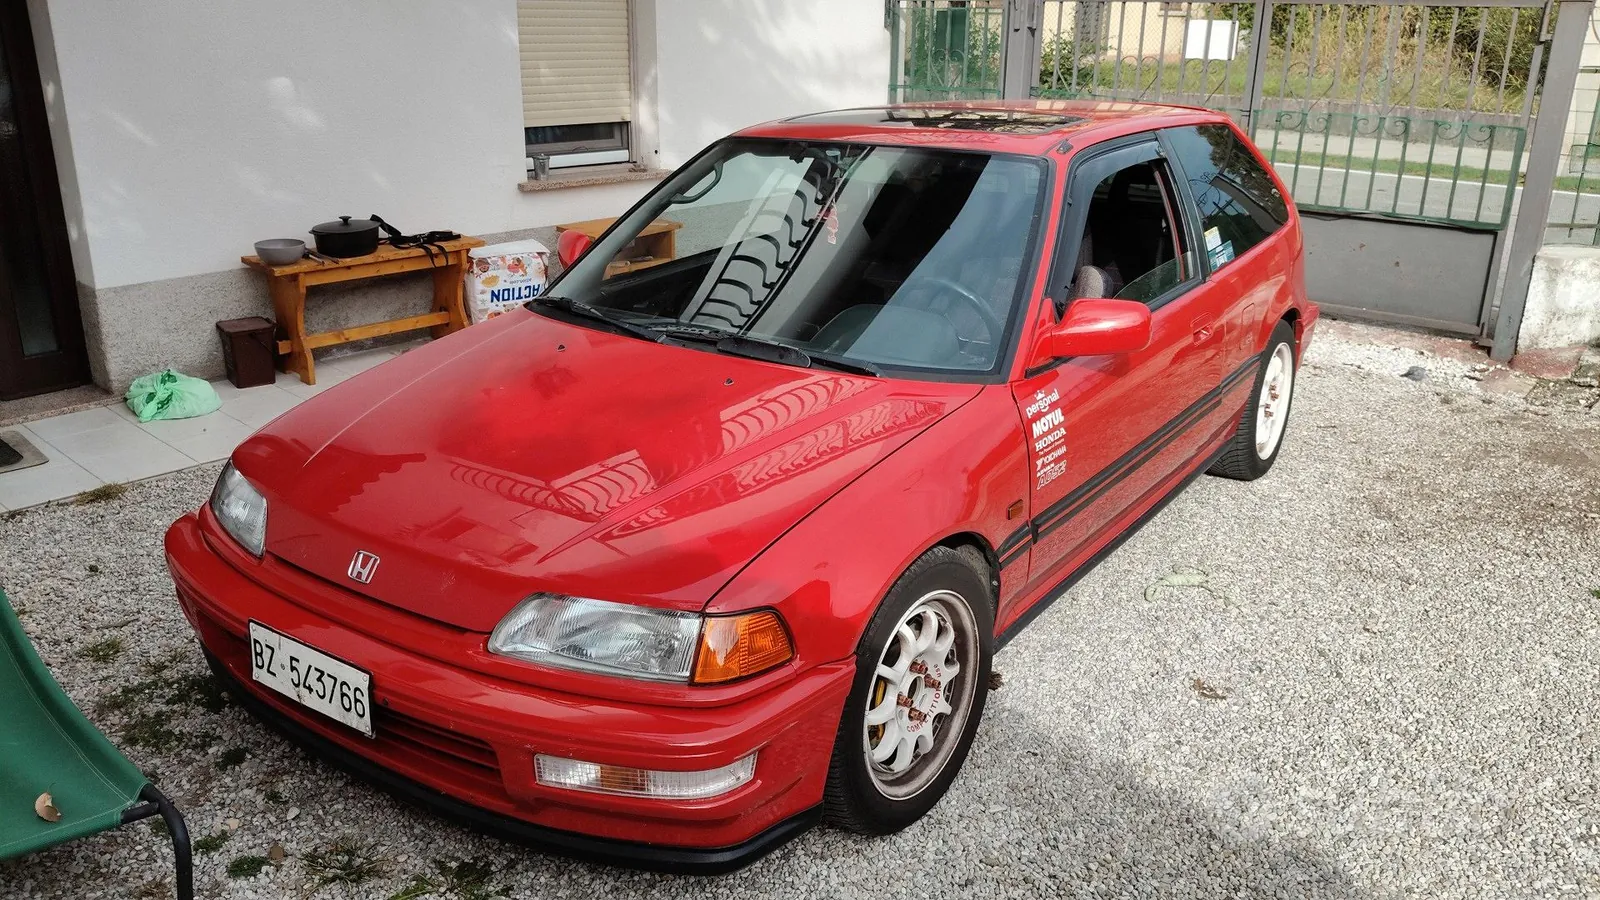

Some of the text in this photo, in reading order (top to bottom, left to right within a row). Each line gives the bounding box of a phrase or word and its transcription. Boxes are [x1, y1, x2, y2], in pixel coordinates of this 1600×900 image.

[490, 284, 541, 303] ACTION
[1026, 388, 1060, 418] personal
[1032, 407, 1065, 439] MOTUL
[1035, 427, 1067, 452] HONDA
[253, 638, 366, 719] BZ 543766
